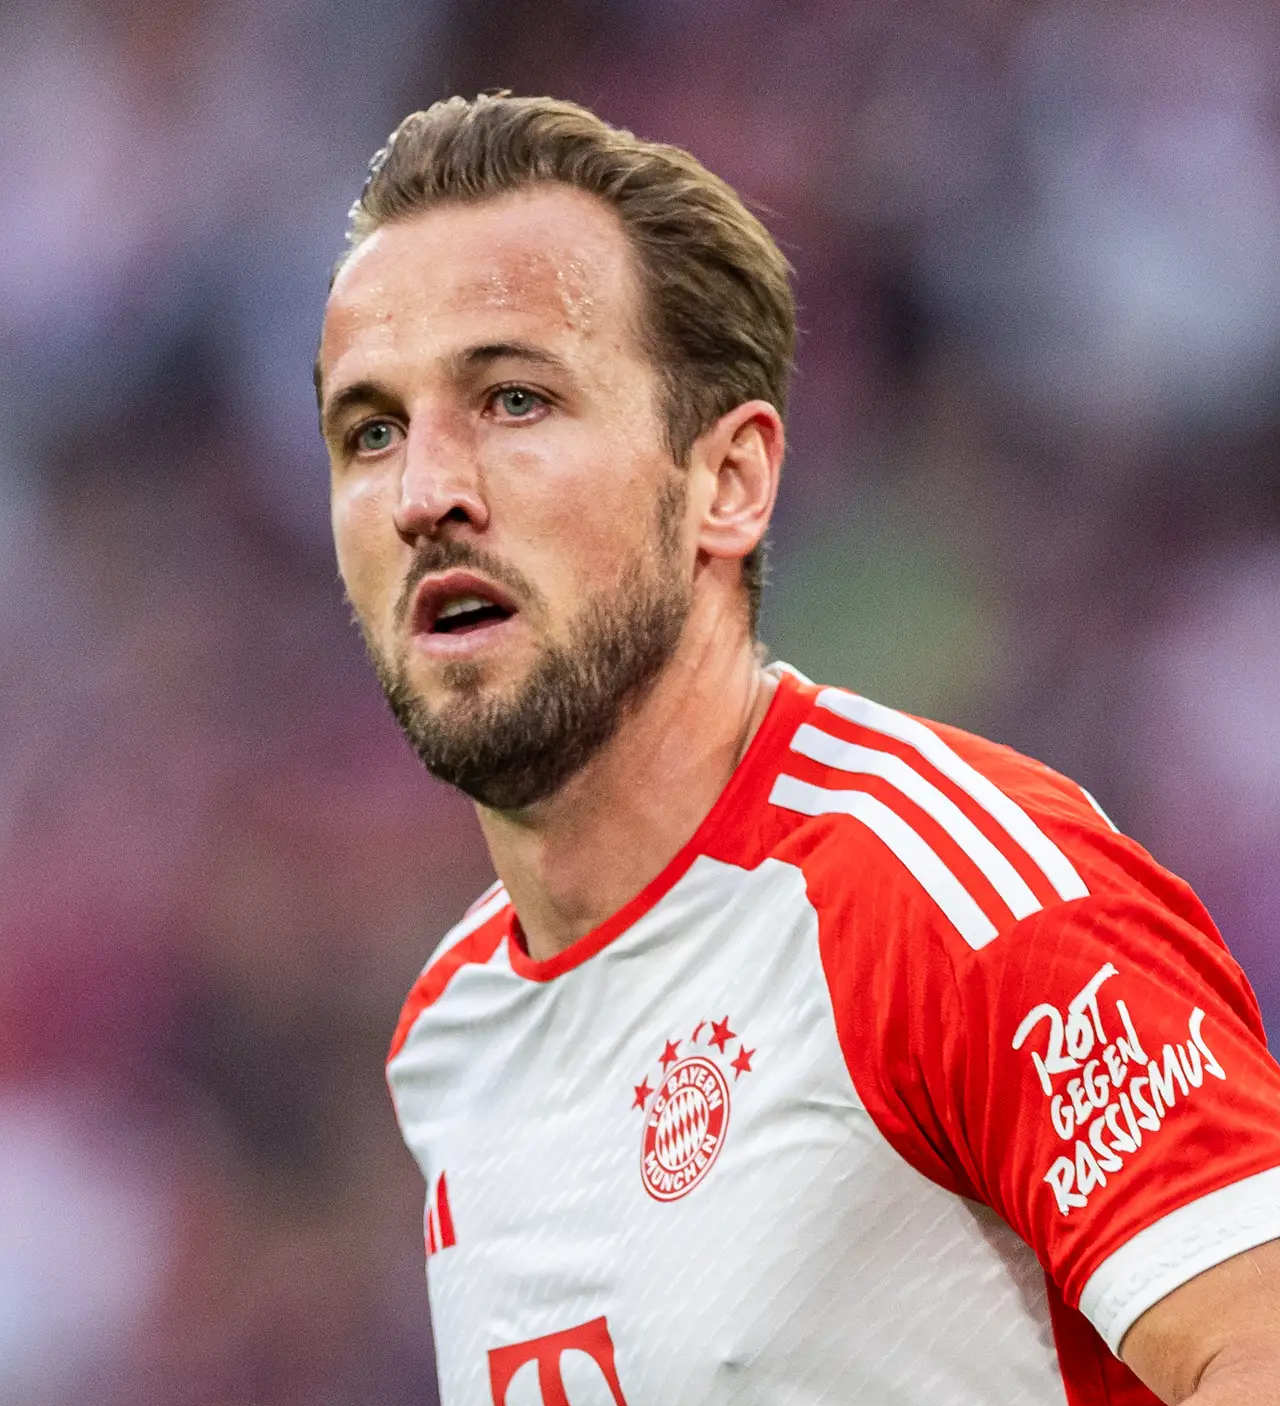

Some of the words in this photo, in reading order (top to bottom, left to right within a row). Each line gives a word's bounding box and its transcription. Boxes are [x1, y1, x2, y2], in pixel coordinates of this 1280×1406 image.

[667, 1066, 722, 1110] BAYERN
[1012, 962, 1119, 1096] ROT
[1051, 1000, 1148, 1140] GEGEN
[1043, 1006, 1226, 1216] RASSISMUS
